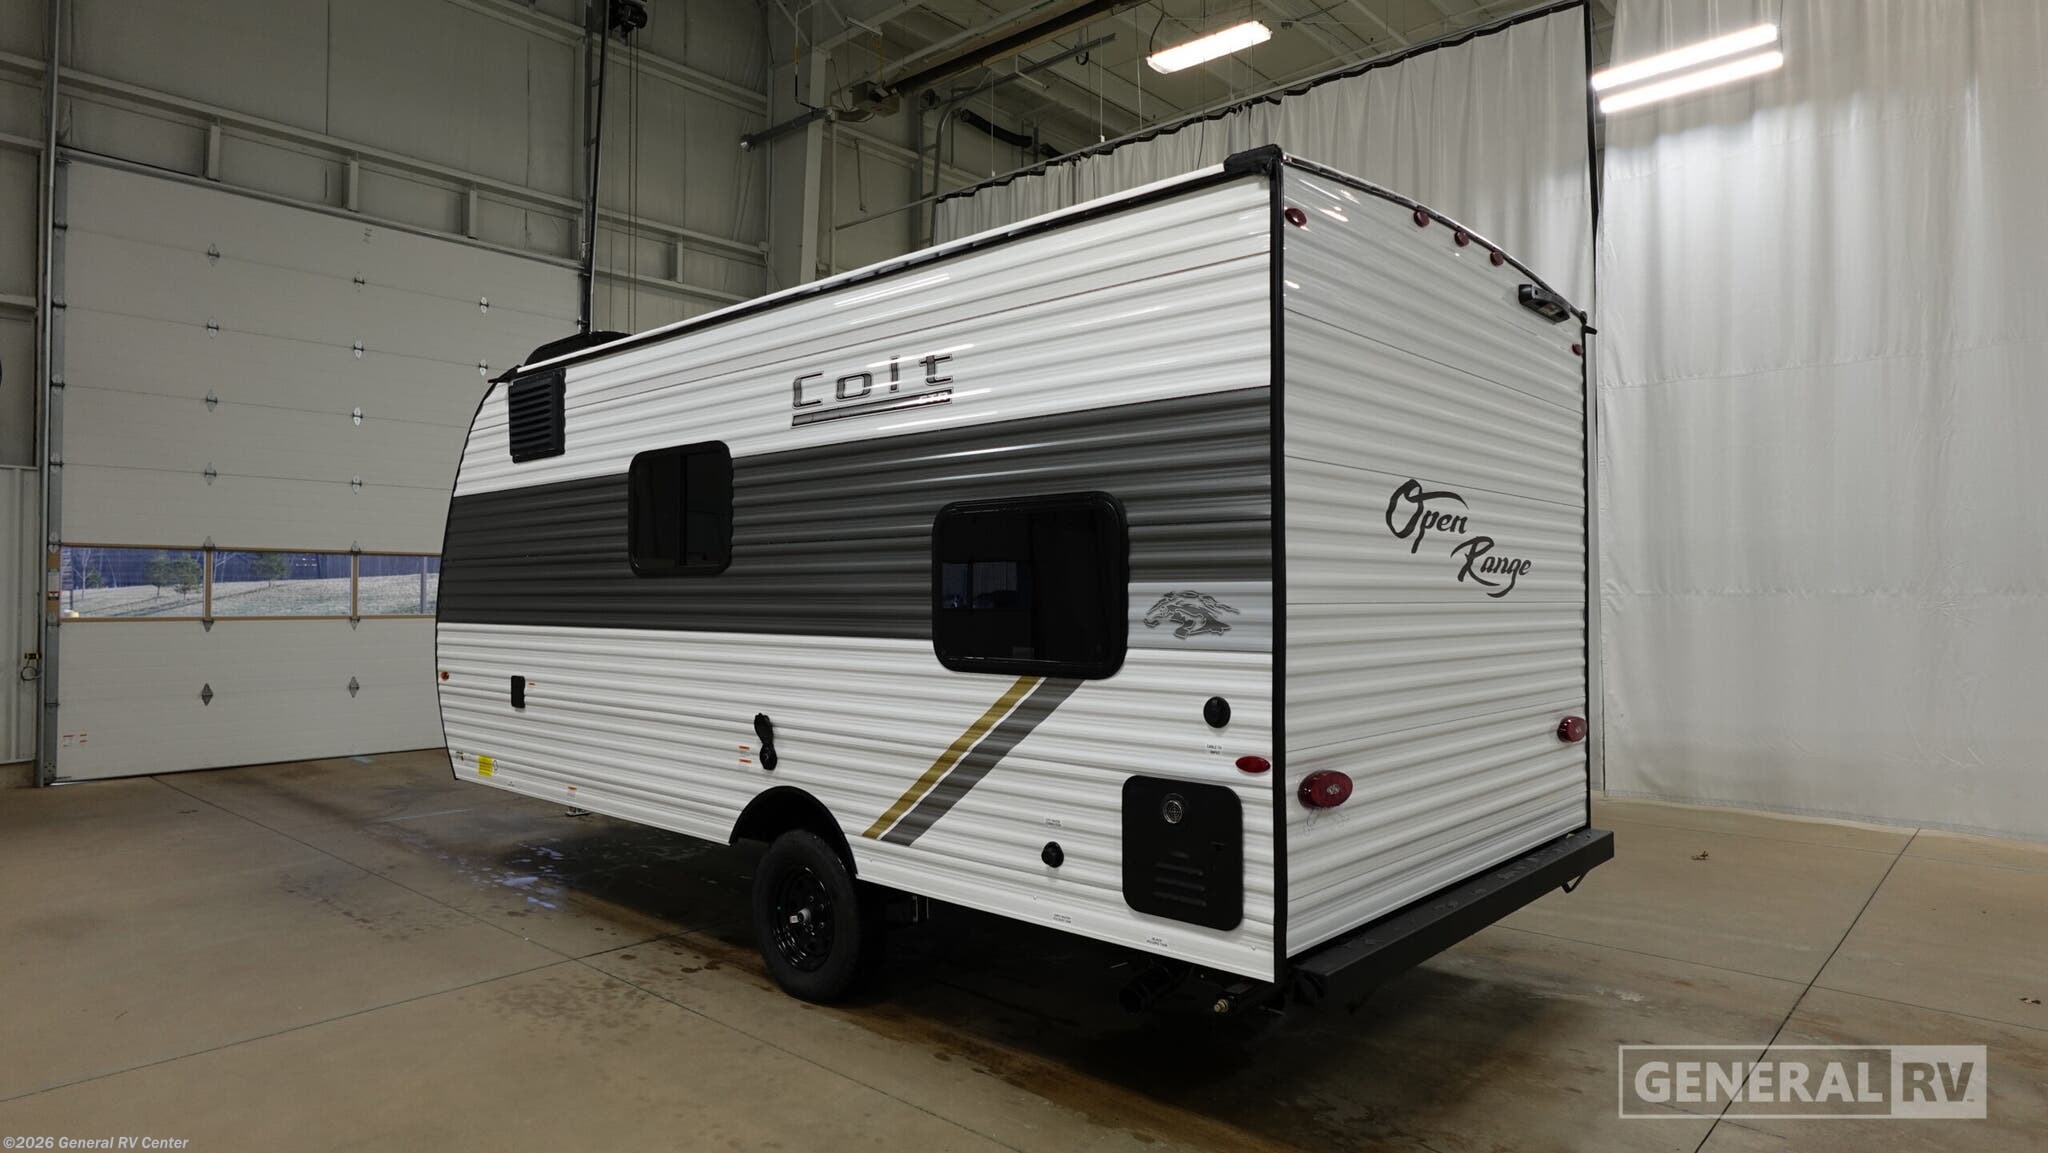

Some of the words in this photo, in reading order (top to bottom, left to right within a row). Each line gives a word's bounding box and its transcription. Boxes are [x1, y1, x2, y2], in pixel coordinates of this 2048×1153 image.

[792, 354, 953, 408] Colt
[1385, 478, 1469, 554] Open
[1450, 535, 1532, 598] Range
